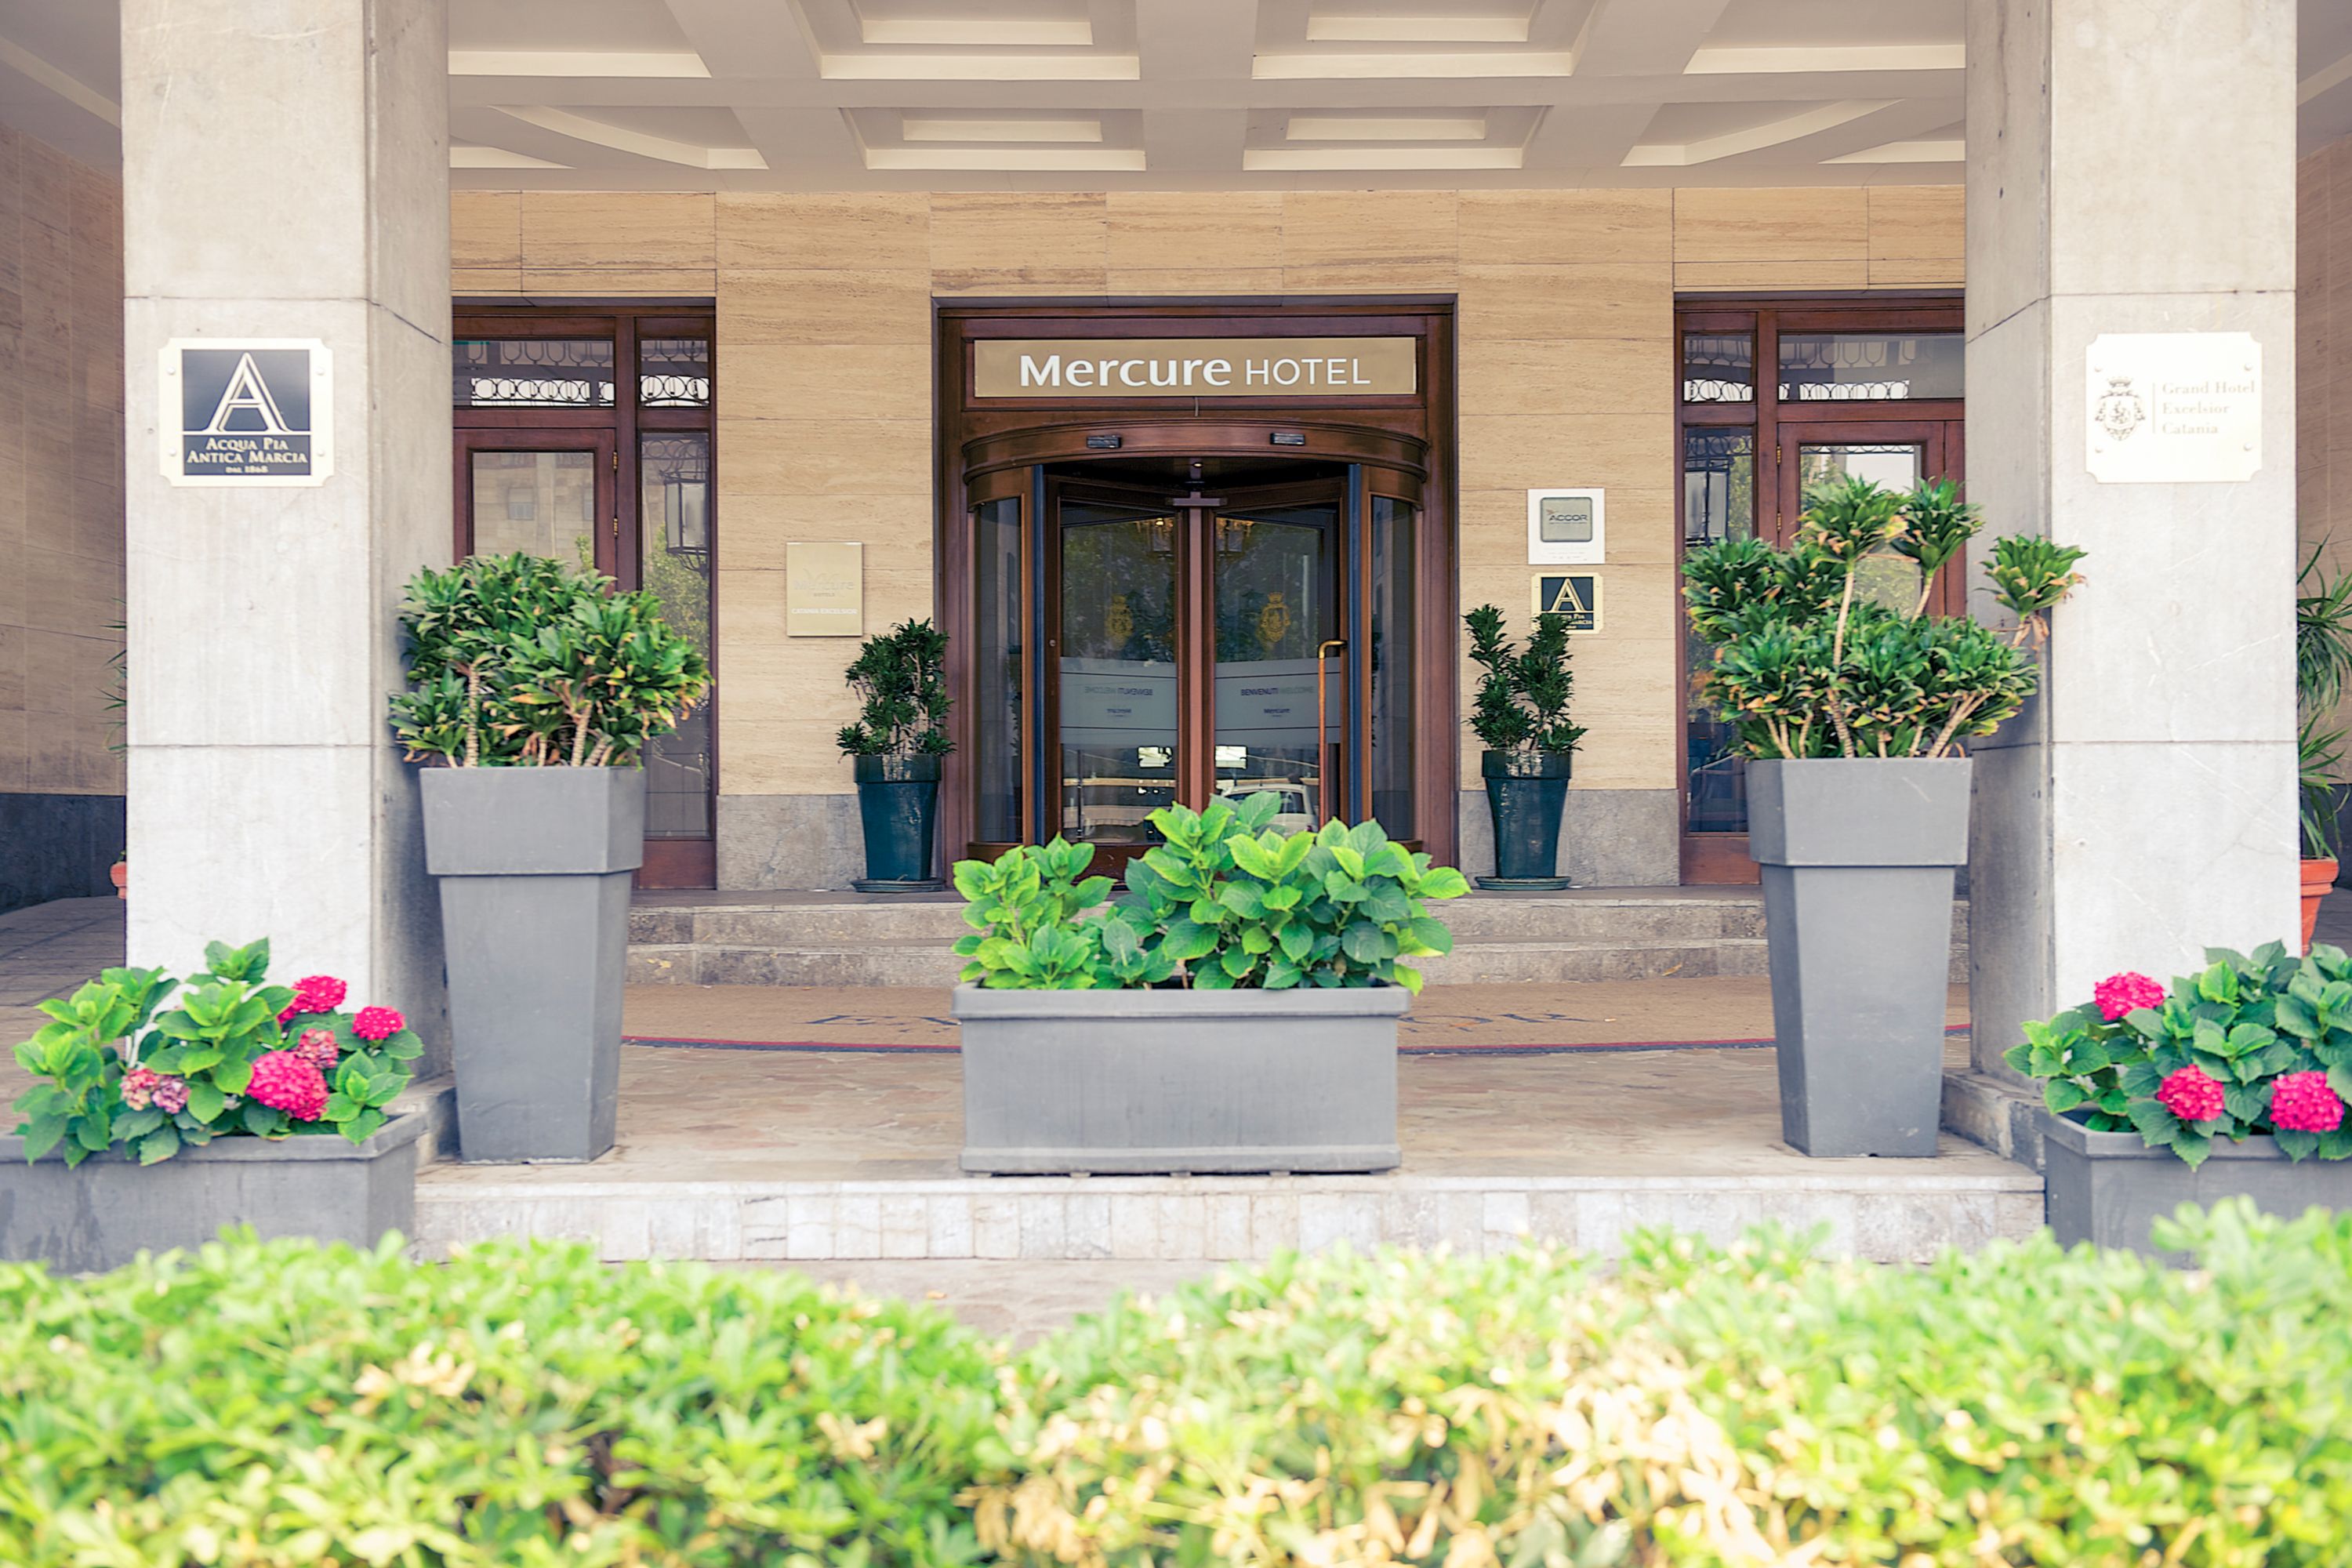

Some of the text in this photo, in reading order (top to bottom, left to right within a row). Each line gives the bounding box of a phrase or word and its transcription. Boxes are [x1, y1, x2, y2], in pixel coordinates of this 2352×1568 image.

[1019, 354, 1372, 387] Mercure HOTEL
[2161, 379, 2256, 394] Grand Hotel
[2161, 401, 2231, 415] Excelsior
[2161, 421, 2220, 434] Catania
[205, 437, 289, 452] ACQUA PIA
[187, 450, 308, 464] ANTICA MARCIA
